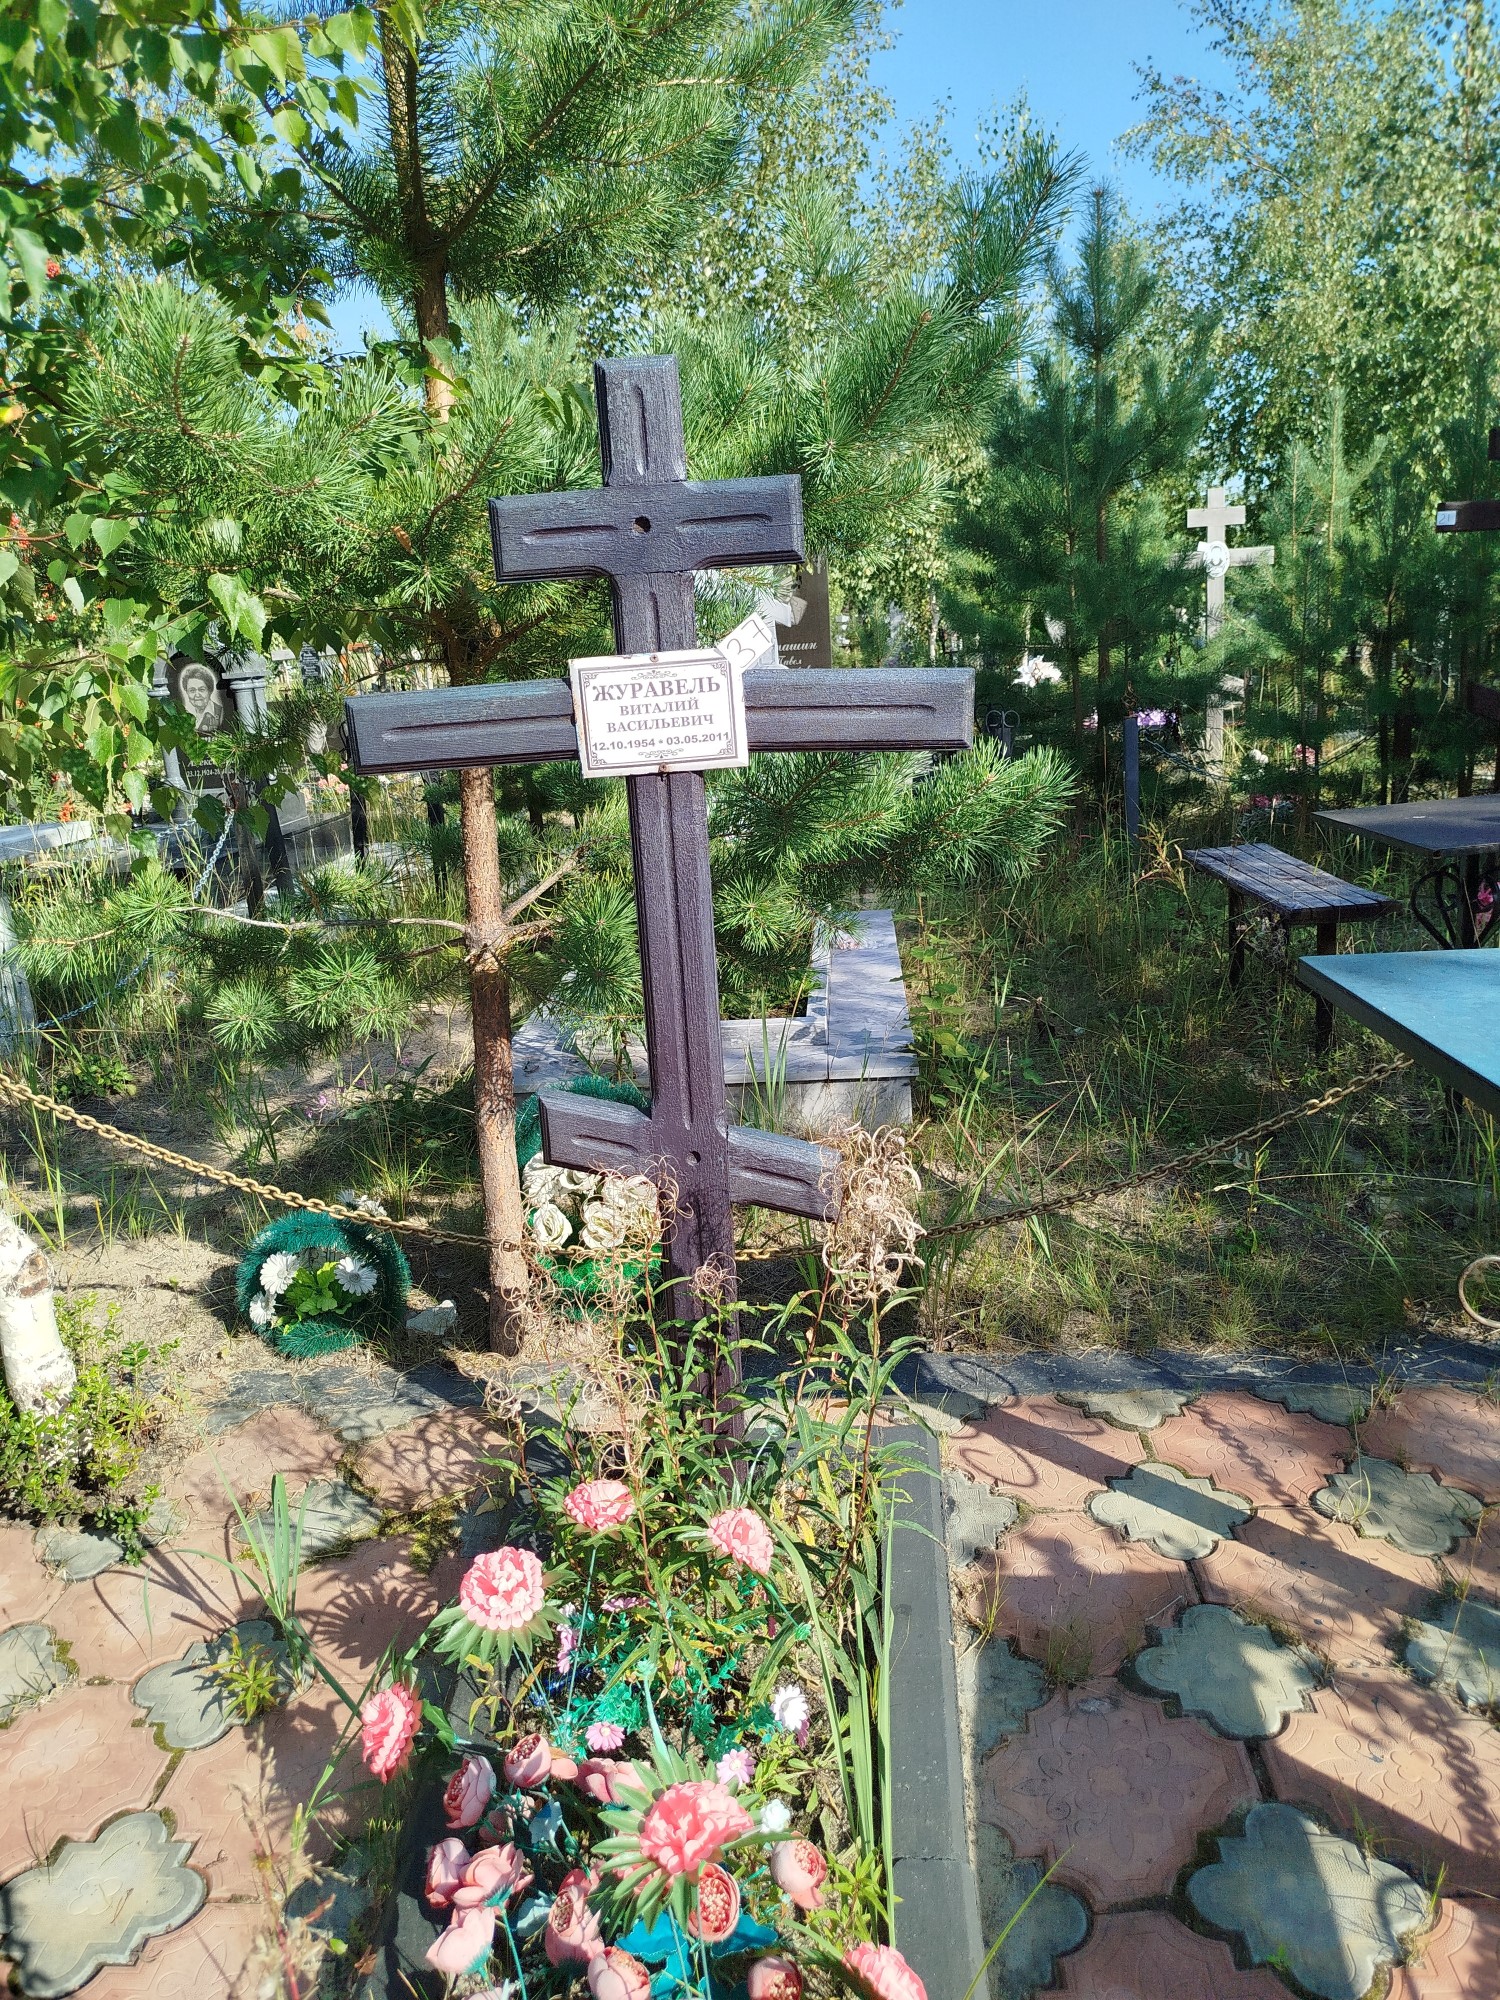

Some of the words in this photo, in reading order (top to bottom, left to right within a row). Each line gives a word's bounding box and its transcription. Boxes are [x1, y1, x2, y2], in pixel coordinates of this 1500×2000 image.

[726, 619, 771, 668] 37
[592, 676, 721, 702] ЖУРАВЕЛЬ
[619, 696, 700, 717] ВИТАЛИЙ
[606, 713, 715, 734] ВАСИЛЬЕВИЧ
[592, 738, 656, 751] 12.10.1954
[666, 731, 730, 746] 03.05.2011
